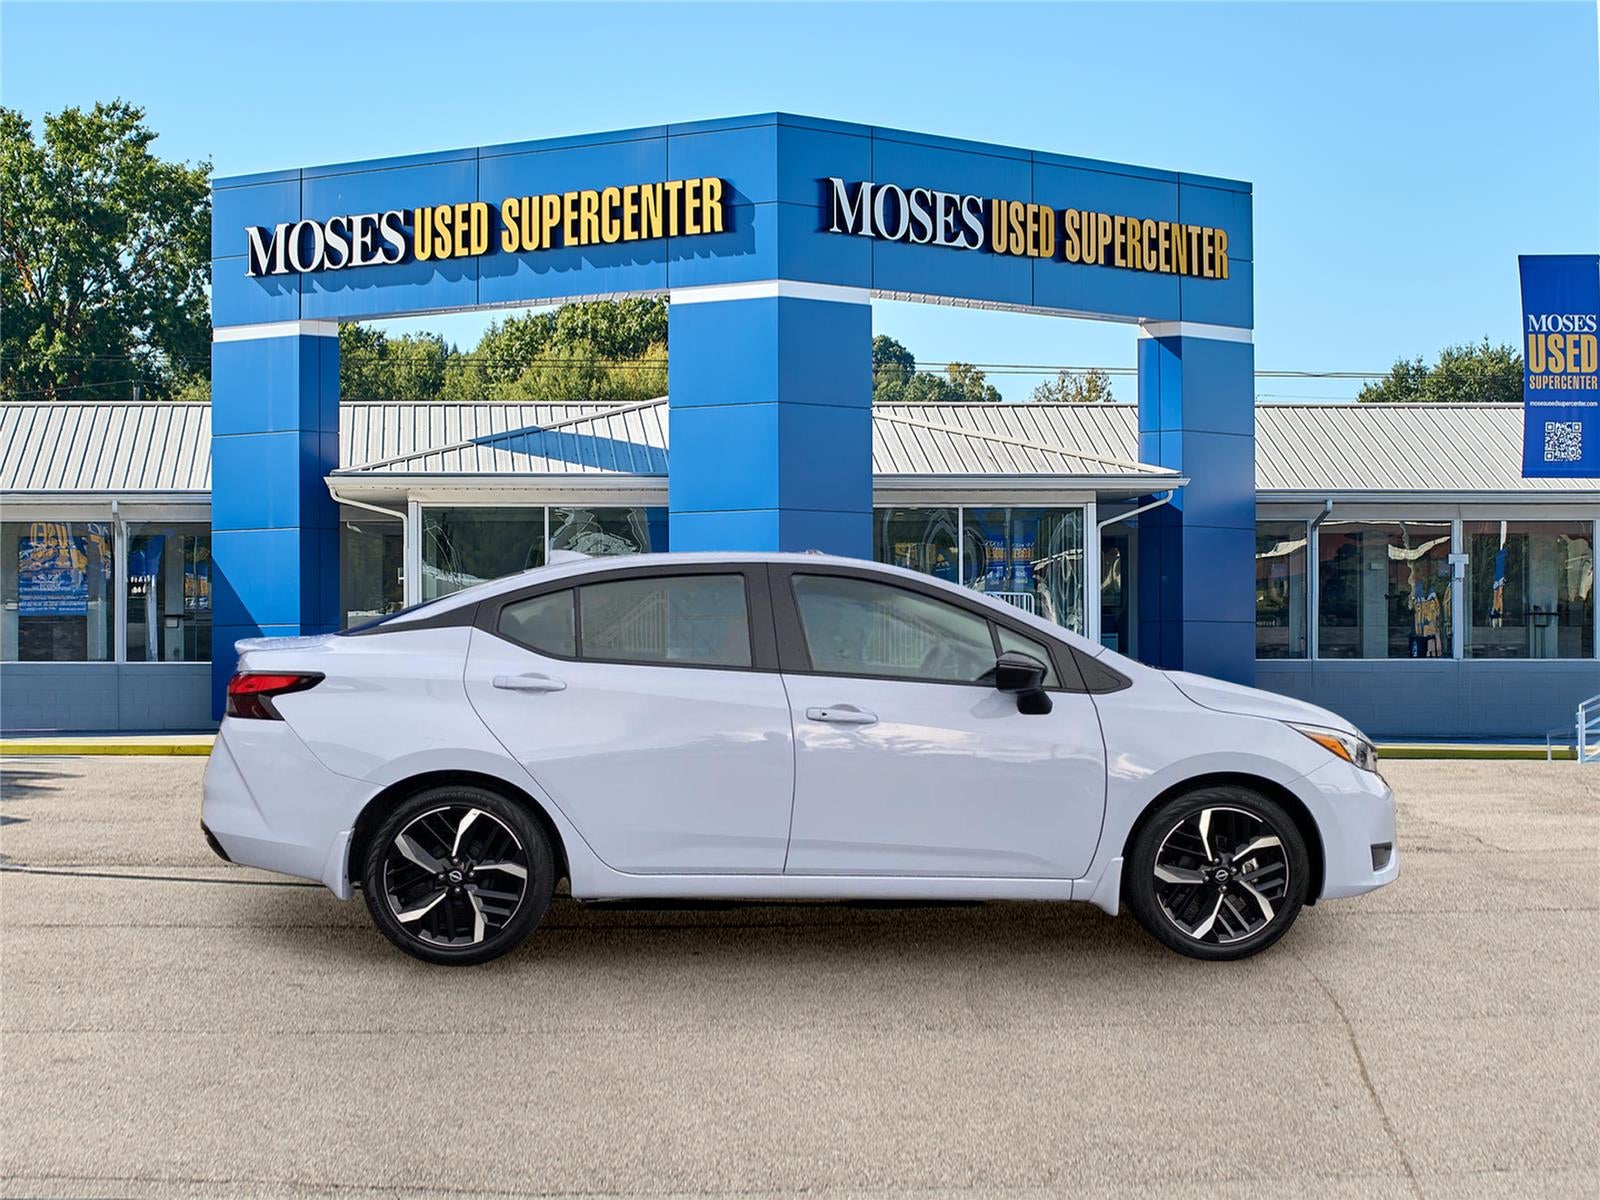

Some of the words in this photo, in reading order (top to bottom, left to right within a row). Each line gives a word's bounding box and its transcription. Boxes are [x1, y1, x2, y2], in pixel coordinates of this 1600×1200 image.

[244, 210, 407, 278] MOSES
[413, 201, 488, 262] USED
[500, 177, 724, 254] SUPERCENTER
[828, 177, 985, 250] MOSES
[991, 198, 1056, 258] USED
[1064, 208, 1229, 280] SUPERCENTER
[1527, 314, 1597, 333] MOSES
[1528, 333, 1598, 374] USED
[1529, 375, 1598, 390] SUPERCENTER
